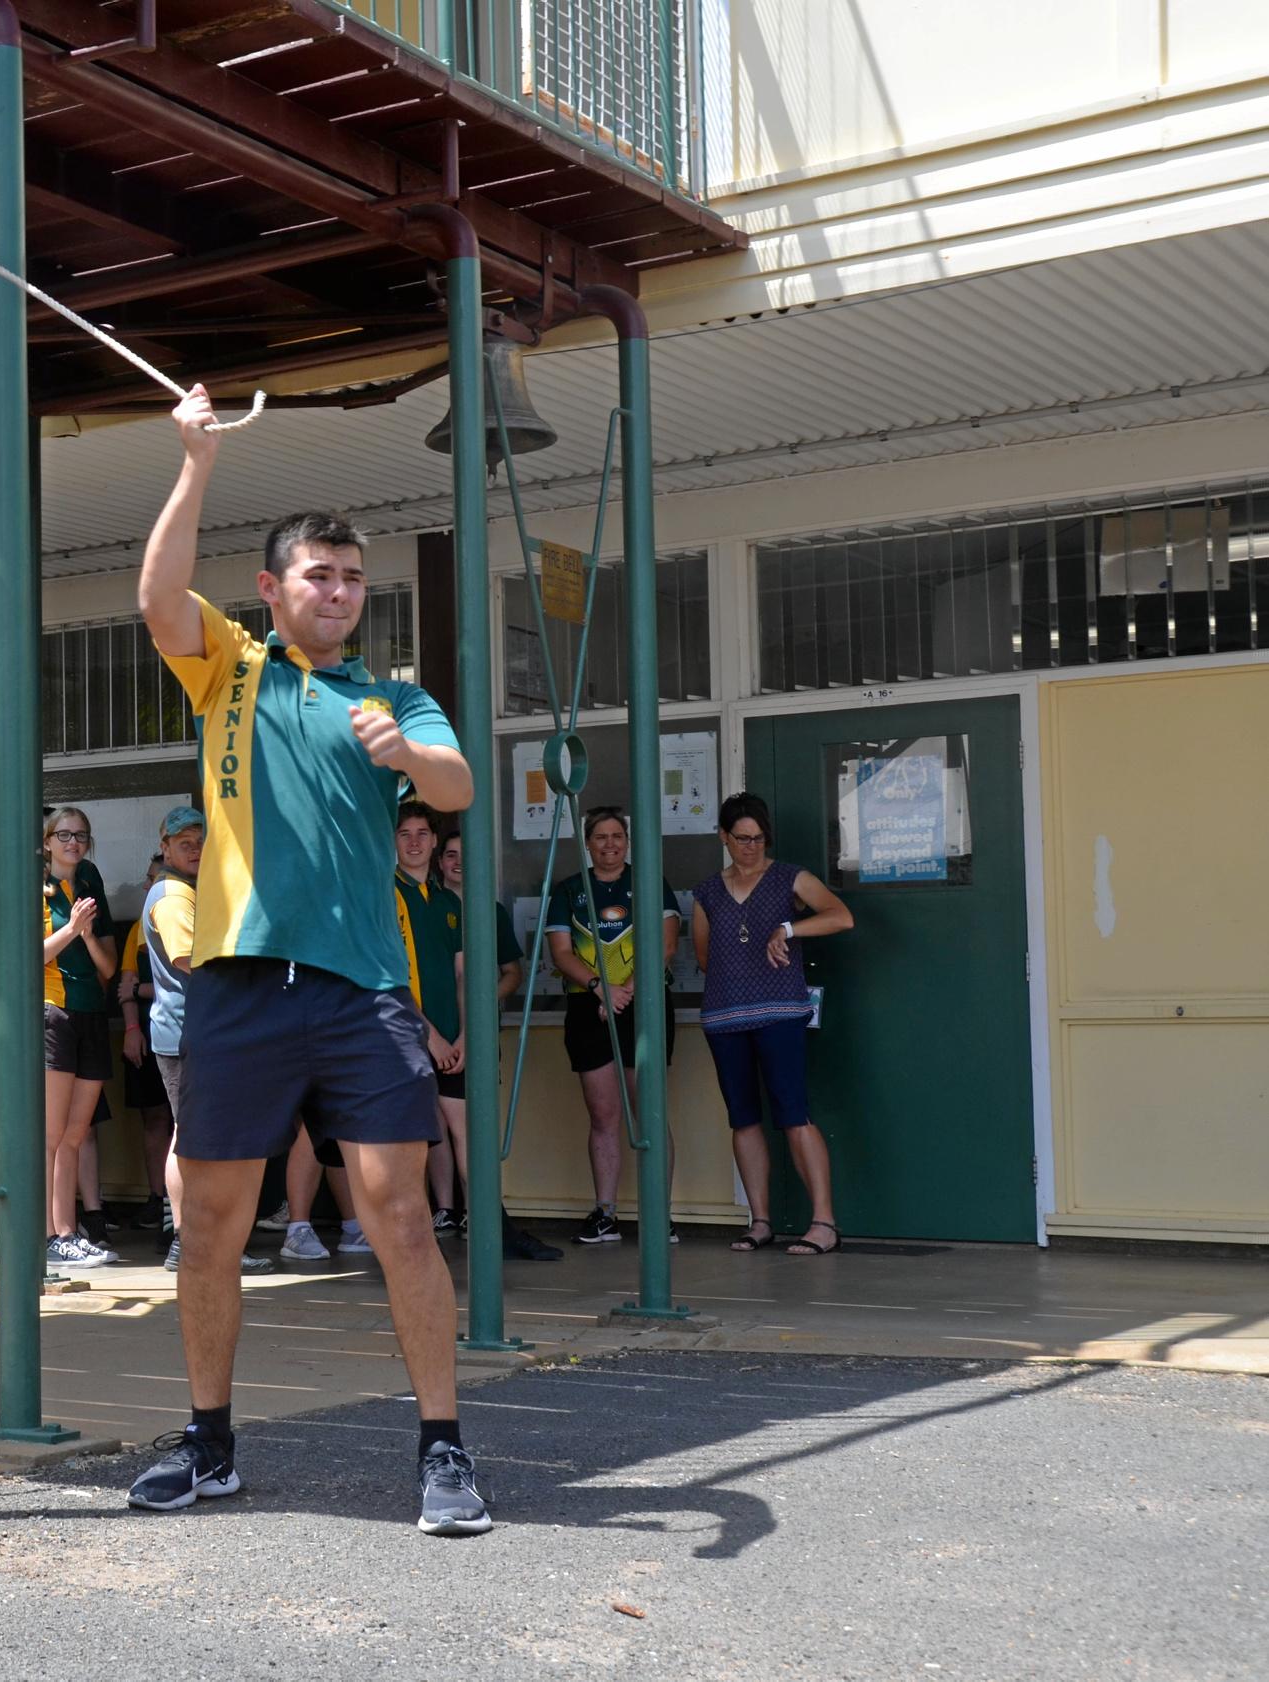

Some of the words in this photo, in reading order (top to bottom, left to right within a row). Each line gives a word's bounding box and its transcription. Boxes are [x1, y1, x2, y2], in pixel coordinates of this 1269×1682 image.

[543, 548, 560, 569] FIRE
[563, 553, 581, 575] BELL
[878, 689, 888, 697] 16
[220, 660, 250, 800] SENIOR
[883, 785, 916, 800] Only
[866, 815, 936, 830] attitudes
[870, 829, 933, 845] allowed
[872, 844, 931, 863] beyond
[862, 861, 891, 875] this
[895, 861, 940, 877] point.
[587, 921, 623, 929] Eolution
